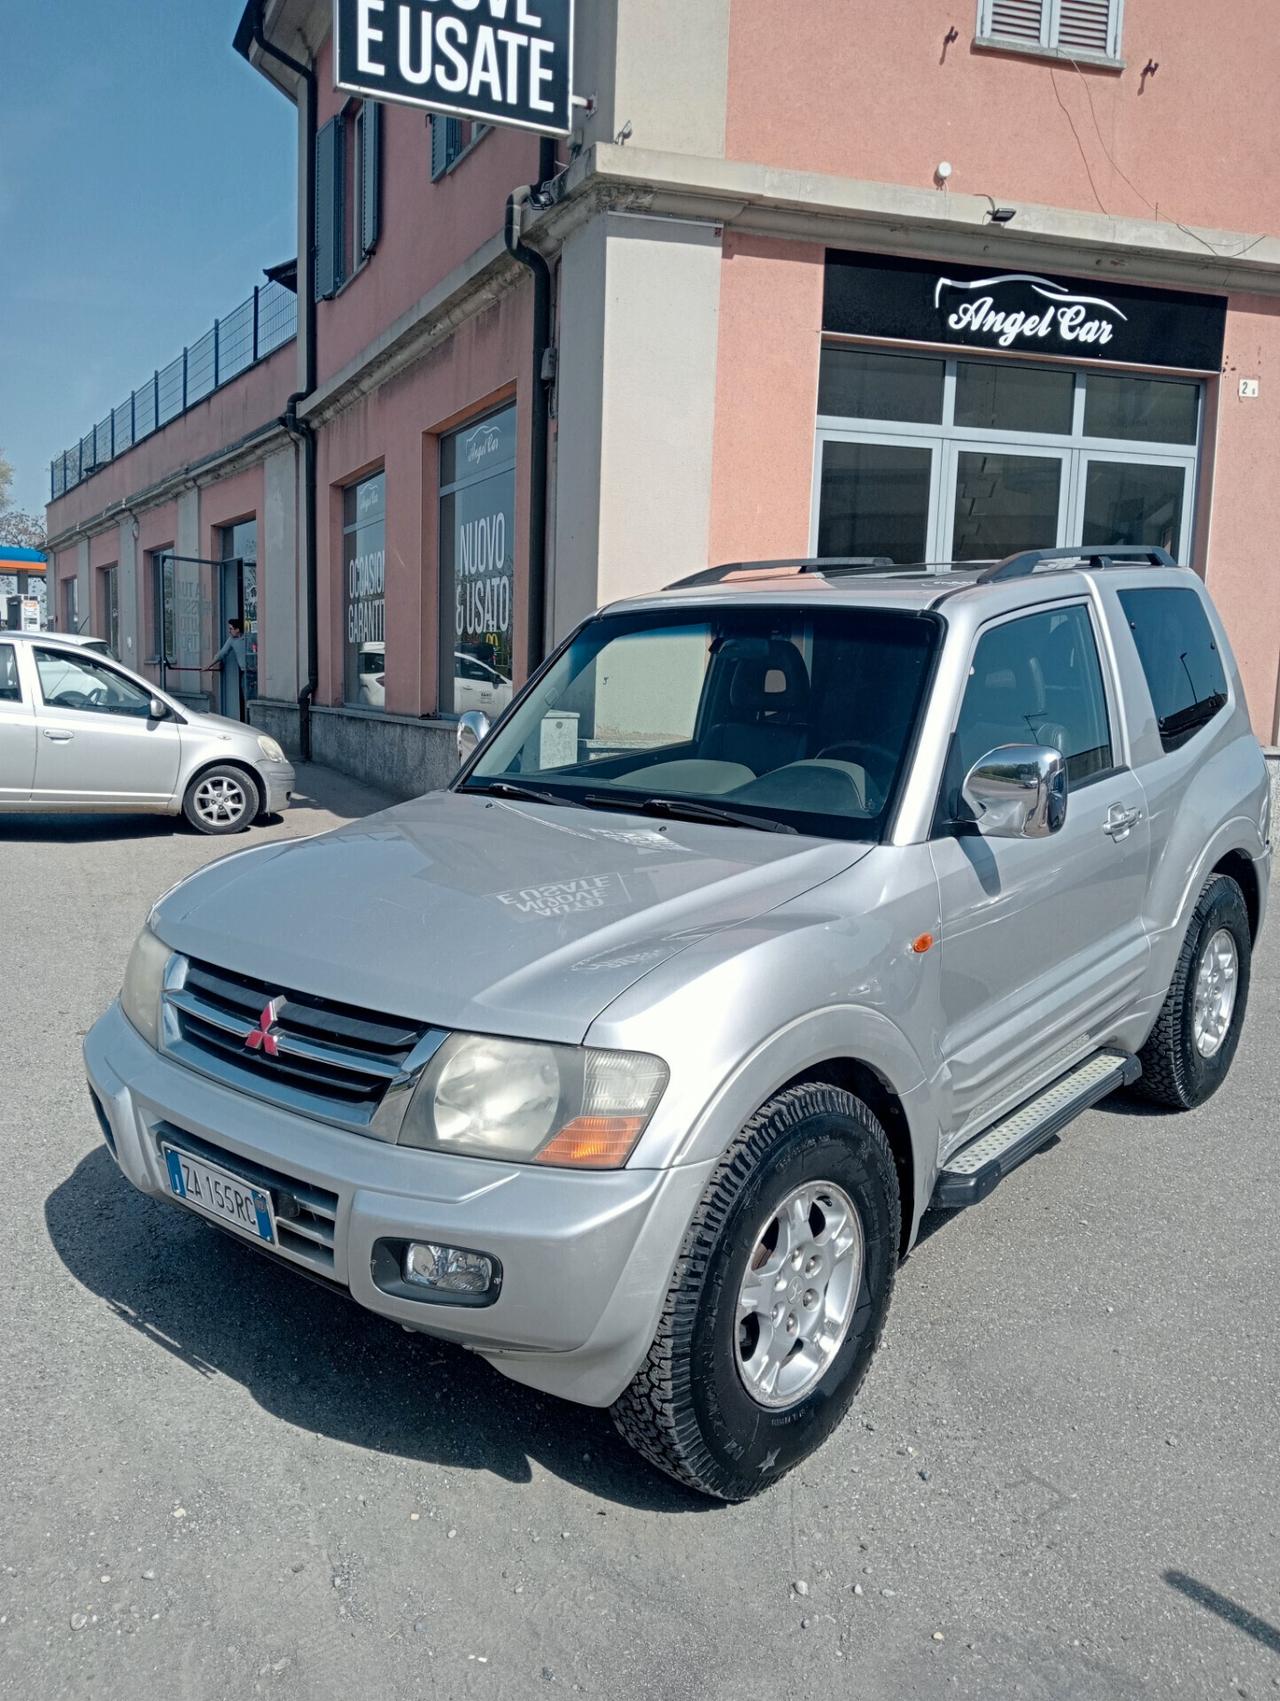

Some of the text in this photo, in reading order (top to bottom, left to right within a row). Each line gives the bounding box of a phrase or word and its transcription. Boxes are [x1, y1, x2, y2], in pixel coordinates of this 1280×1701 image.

[357, 0, 555, 113] E USATE
[949, 297, 1113, 346] Angel Car
[1241, 381, 1248, 395] 2
[460, 512, 505, 576] NUOVO
[466, 575, 509, 634] USATO
[182, 1164, 257, 1225] ZA 155RC
